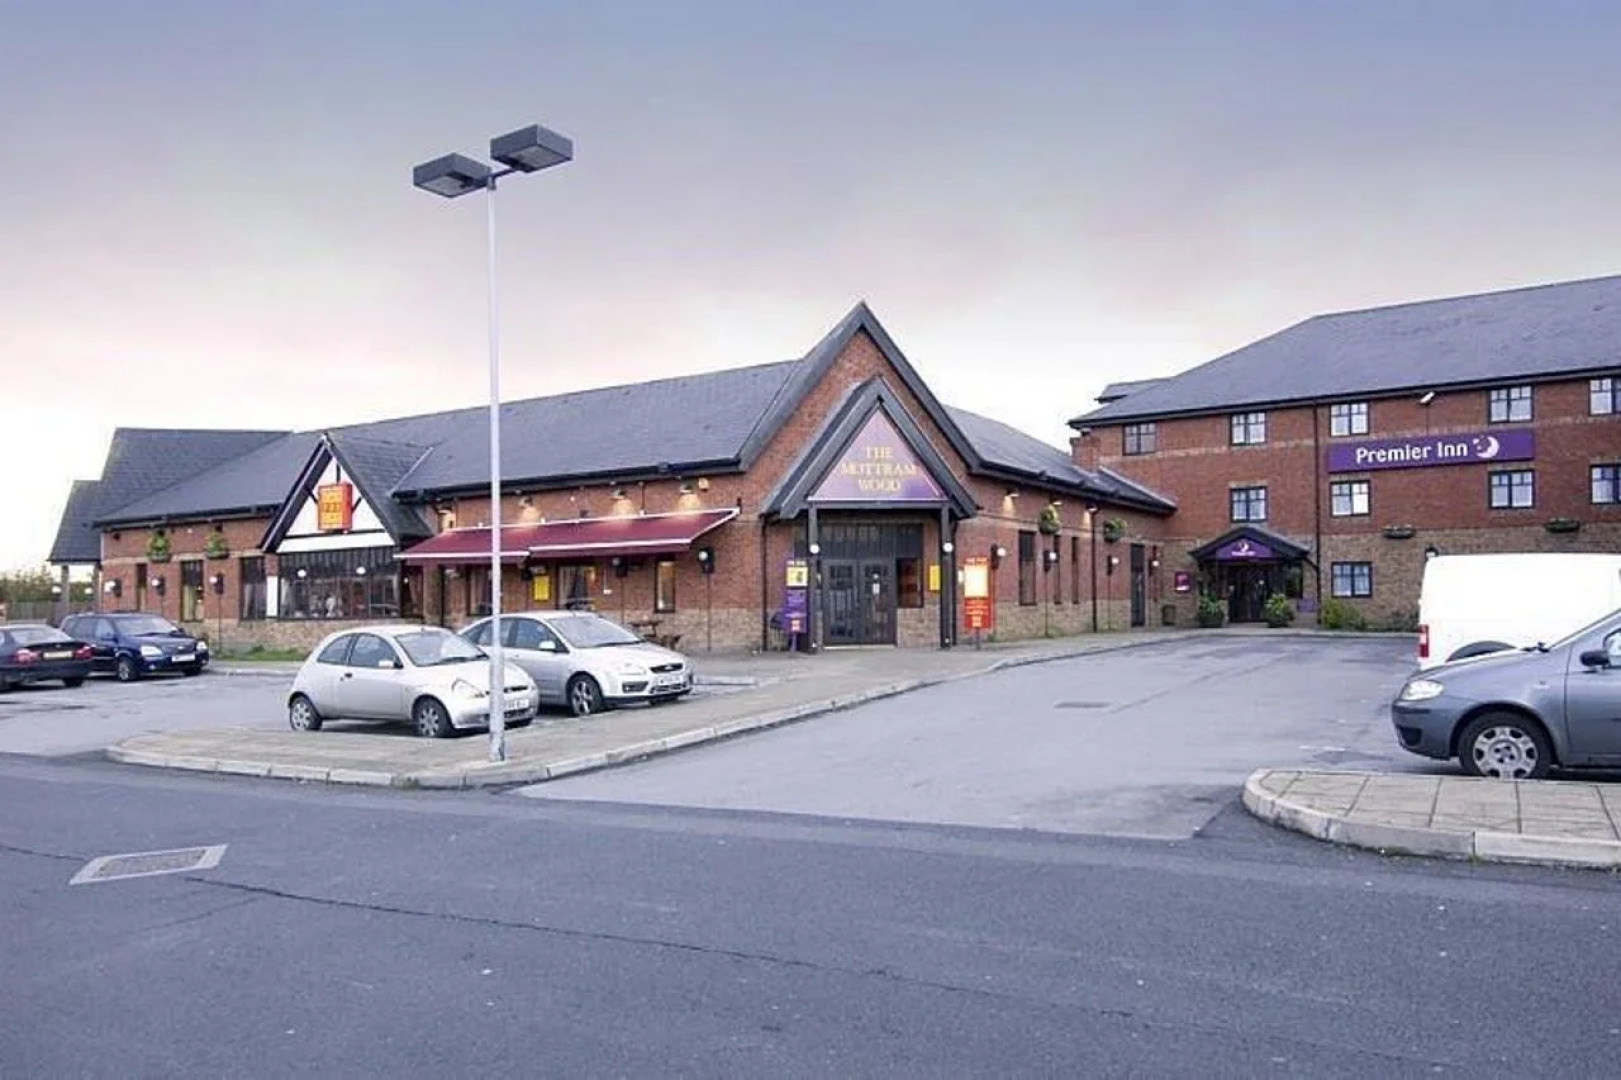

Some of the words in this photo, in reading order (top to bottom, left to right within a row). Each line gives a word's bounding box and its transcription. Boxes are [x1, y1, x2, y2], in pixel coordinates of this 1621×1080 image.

[866, 446, 892, 458] THE
[1356, 444, 1431, 464] Premier
[1438, 441, 1468, 458] Inn
[858, 479, 901, 491] WOOD
